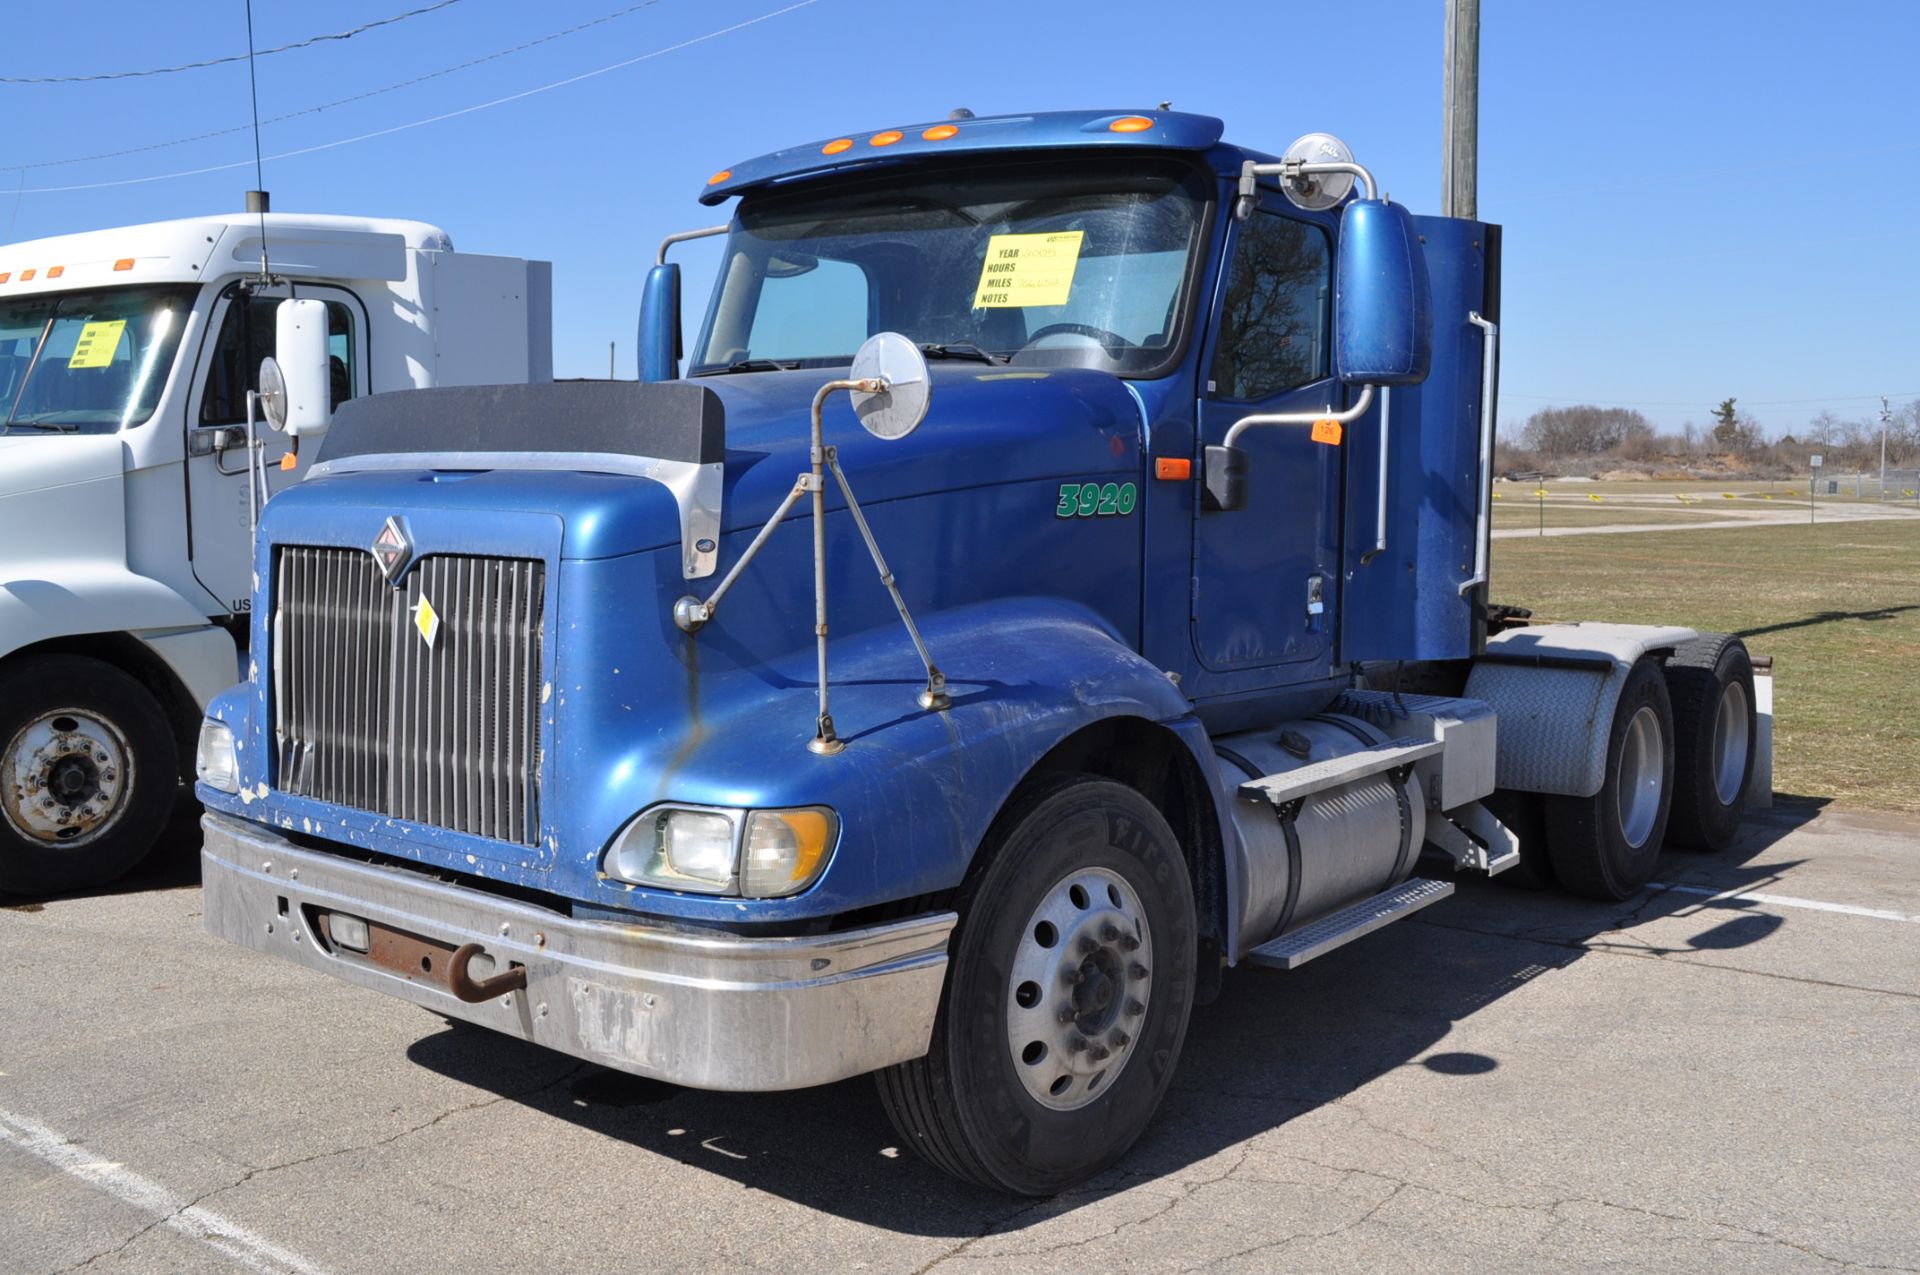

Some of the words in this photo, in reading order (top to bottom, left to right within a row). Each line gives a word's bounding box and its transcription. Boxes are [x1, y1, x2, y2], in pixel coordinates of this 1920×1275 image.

[999, 249, 1019, 258] YEAR
[987, 263, 1016, 273] HOURS
[986, 278, 1012, 288] MILES
[981, 293, 1008, 303] NOTES
[1056, 482, 1137, 517] 3920
